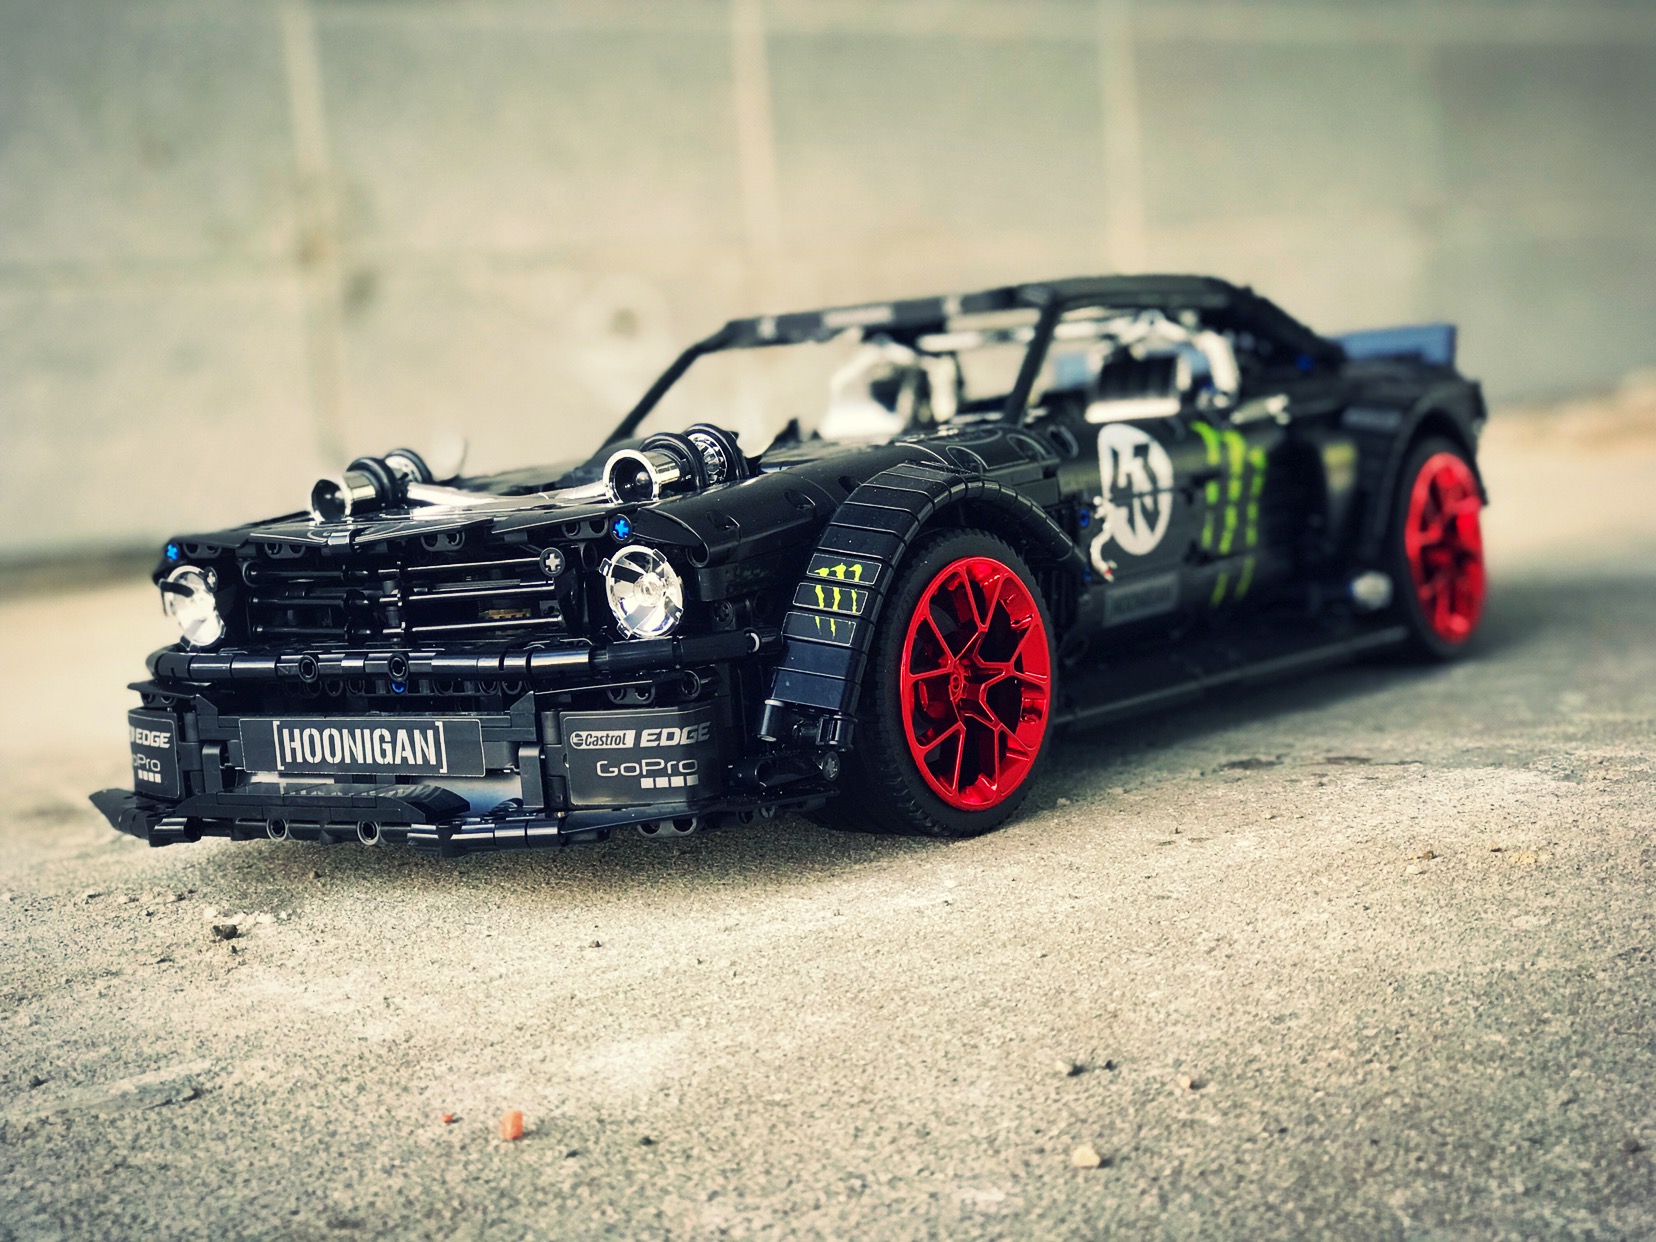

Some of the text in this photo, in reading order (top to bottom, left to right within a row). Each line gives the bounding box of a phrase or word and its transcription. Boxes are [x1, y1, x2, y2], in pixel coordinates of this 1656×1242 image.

[1109, 444, 1160, 535] 43
[136, 728, 172, 749] EDGE
[585, 722, 711, 747] Castrol EDGE
[133, 754, 160, 772] oPro
[597, 759, 698, 776] GoPro
